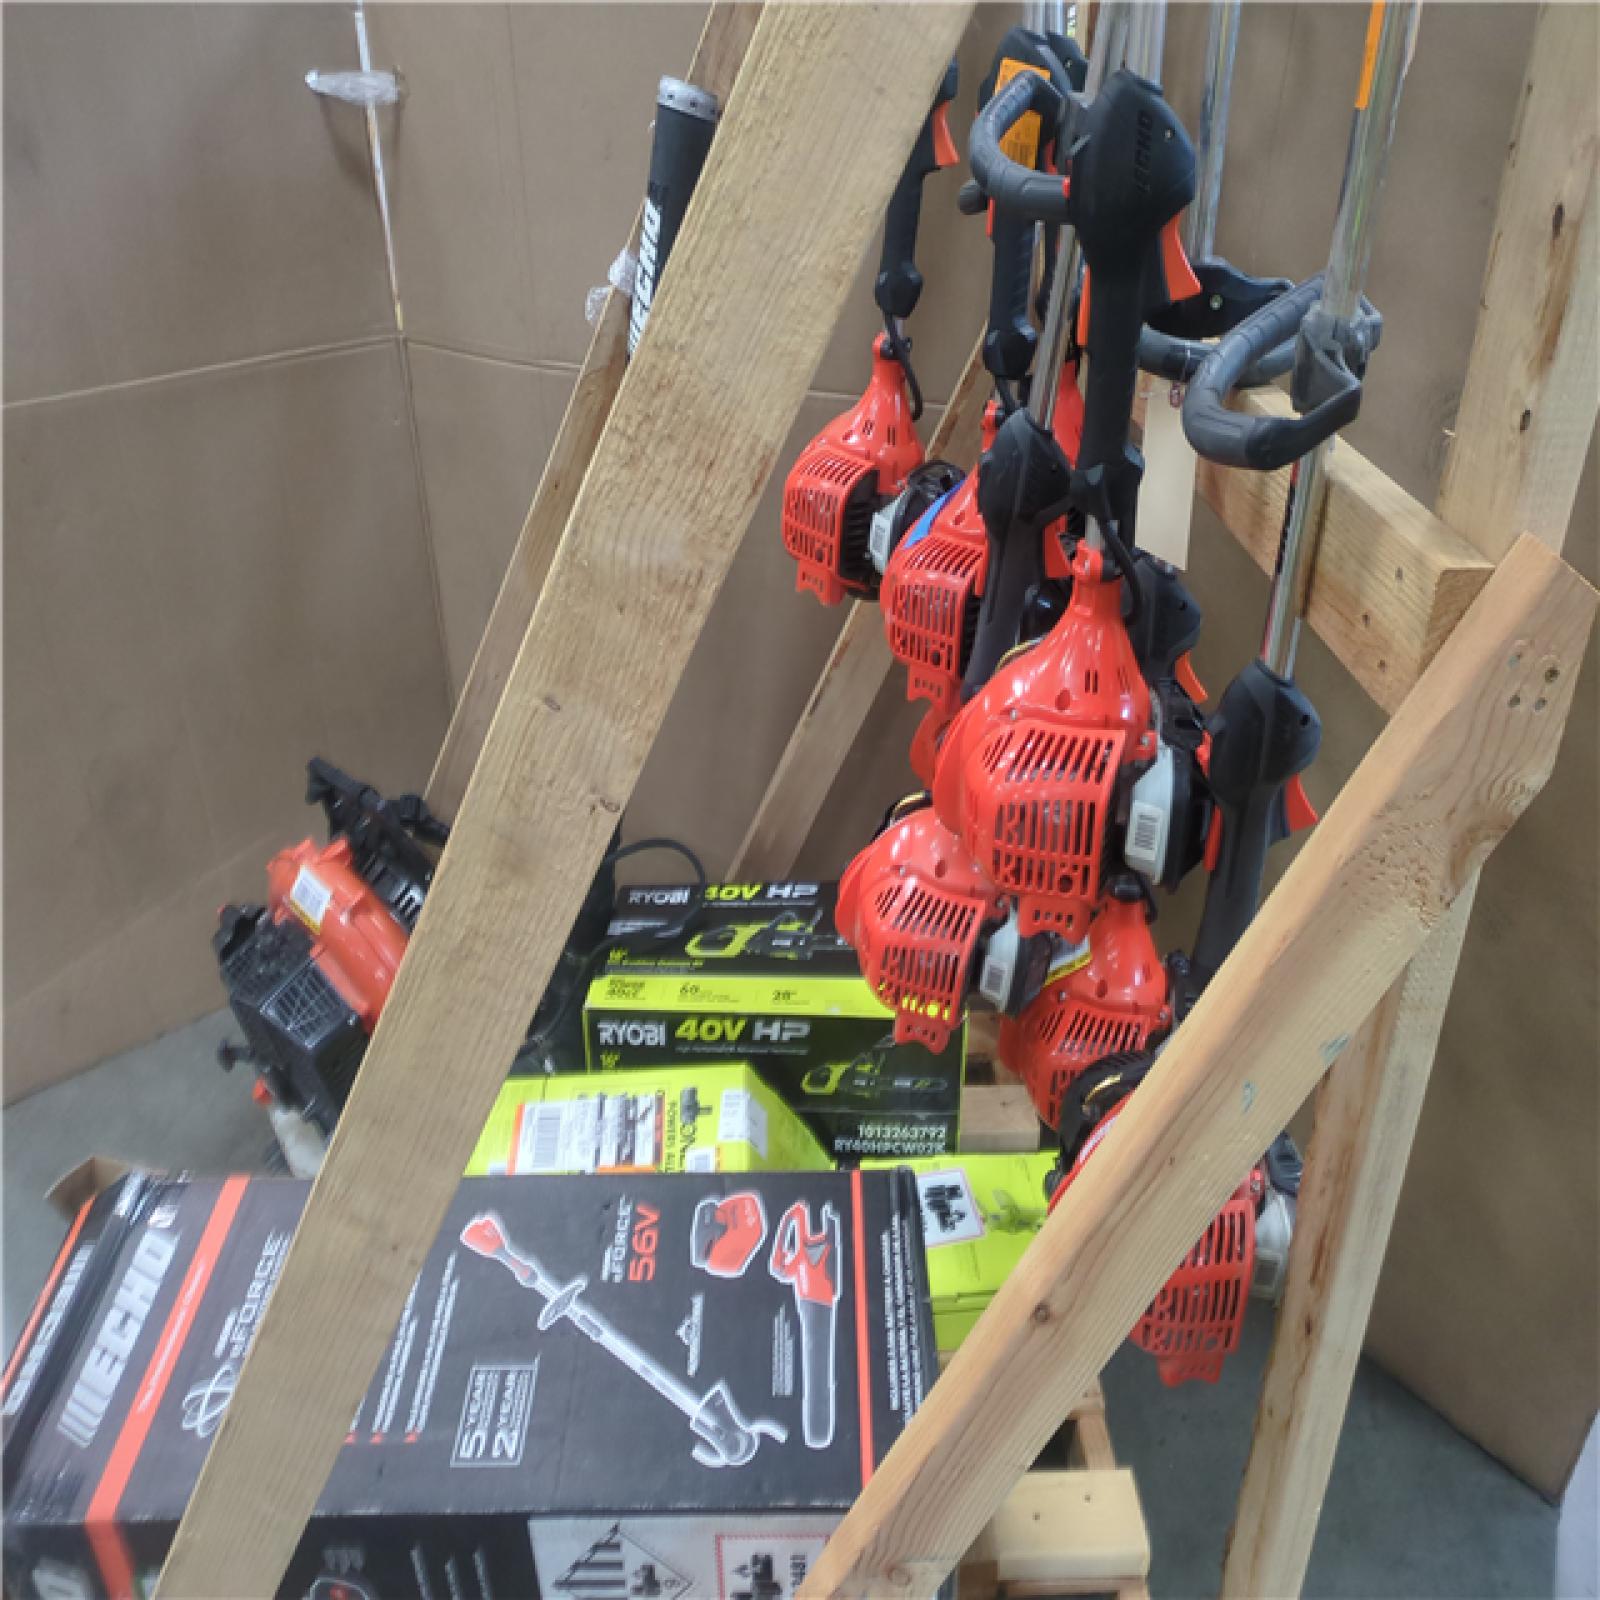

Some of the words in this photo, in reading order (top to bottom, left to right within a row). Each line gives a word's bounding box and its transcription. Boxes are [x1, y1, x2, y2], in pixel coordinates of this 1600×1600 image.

[627, 887, 692, 905] RYOBI
[766, 883, 820, 900] HP
[597, 1020, 666, 1047] RYOBI
[675, 1018, 747, 1042] 40V
[752, 1019, 810, 1042] HP
[628, 1202, 661, 1283] 56V
[71, 1230, 181, 1418] ECHO
